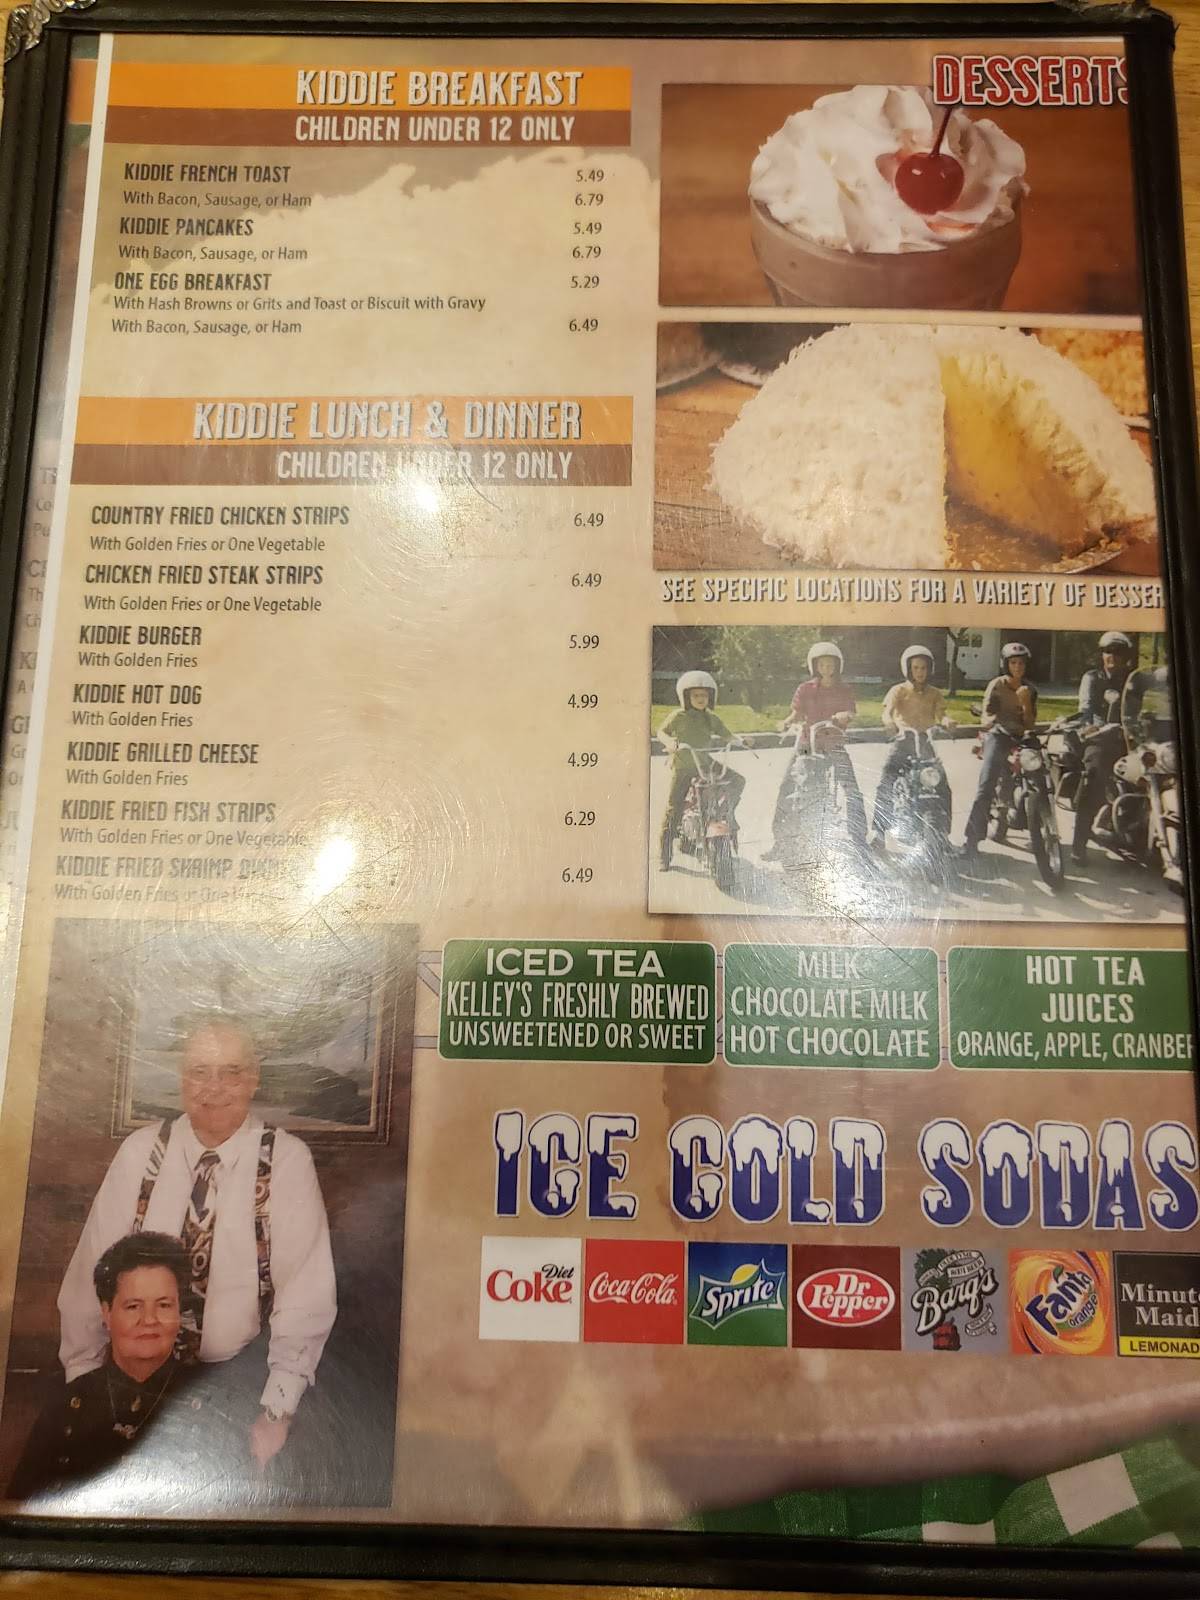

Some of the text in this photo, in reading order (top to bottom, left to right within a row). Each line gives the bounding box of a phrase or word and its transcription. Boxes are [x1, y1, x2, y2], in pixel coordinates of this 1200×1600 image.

[296, 70, 583, 106] KIDDIE BREAKFAST
[296, 116, 575, 141] CHILDREN UNDER 12 ONLY
[124, 163, 291, 183] KIDDIE FRENCH TOAST
[576, 169, 604, 182] 5.49
[124, 190, 312, 210] With Bacon, Sausage, or Ham
[575, 193, 604, 206] 6.79
[120, 216, 254, 236] KIDDIE PANCAKES
[573, 222, 602, 235] 5.49
[119, 245, 308, 263] With Bacon, Sausage, or Ham
[572, 246, 601, 259] 6.79
[114, 272, 272, 291] ONE EGG BREAKFAST
[571, 275, 599, 288] 5.29
[114, 295, 486, 312] With Hash Browns or Grits and Toast or Biscuit with Gravy
[112, 319, 302, 337] With Bacon, Sausage, or Ham
[569, 319, 599, 332] 6.49
[193, 401, 581, 440] KIDDIE LUNCH & DINNER
[277, 451, 386, 479] CHILDREN
[482, 451, 506, 479] 12
[516, 451, 573, 479] ONLY
[91, 506, 350, 525] COUNTRY FRIED CHICKEN STRIPS
[574, 512, 604, 527] 6.49
[90, 535, 326, 554] With Golden Fries or One Vegetable
[85, 564, 323, 584] CHICKEN FRIED STEAK STRIPS
[571, 573, 602, 587] 6.49
[660, 577, 696, 602] SEE
[702, 577, 788, 602] SPECIFIC
[795, 577, 902, 603] LOCATIONS
[910, 578, 946, 603] FOR
[953, 579, 967, 604] A
[972, 580, 1056, 606] VARIETY
[1063, 582, 1086, 607] OF
[84, 594, 322, 615] With Golden Fries or One Vegetable
[79, 625, 202, 645] KIDDIE BURGER
[569, 635, 600, 649] 5.99
[78, 652, 198, 668] With Golden Fries
[73, 683, 202, 705] KIDDIE HOT DOG
[568, 693, 598, 708] 4.99
[72, 711, 193, 727] With Golden Fries
[67, 741, 259, 764] KIDDIE GRILLED CHEESE
[568, 752, 598, 767] 4.99
[66, 768, 188, 786] With Golden Fries
[61, 799, 276, 823] KIDDIE FRIED FISH STRIPS
[564, 811, 595, 826] 6.29
[60, 827, 93, 844] With
[97, 828, 146, 844] Golden
[151, 829, 183, 845] Fries
[187, 832, 202, 845] or
[205, 831, 232, 846] One
[56, 855, 109, 877] KIDDIE
[116, 857, 162, 878] FRIED
[170, 858, 232, 879] SHRIMP
[562, 867, 593, 883] 6.49
[54, 883, 87, 899] With
[92, 884, 141, 901] Golden
[486, 948, 665, 978] ICED TEA
[798, 951, 860, 979] MILK
[1026, 955, 1145, 986] HOT TEA
[447, 981, 709, 1021] KELLEY'S FRESHLY BREWED
[730, 986, 928, 1021] CHOCOLATE MILK
[1041, 993, 1134, 1024] JUICES
[450, 1021, 706, 1050] UNSWEETENED OR SWEET
[730, 1025, 930, 1058] HOT CHOCOLATE
[957, 1030, 1040, 1062] ORANGE,
[1044, 1031, 1108, 1062] APPLE,
[494, 1110, 1199, 1231] ICE COLD SODAS
[541, 1263, 574, 1280] Diet
[486, 1268, 573, 1304] Coke
[588, 1271, 677, 1305] Coca-Cola
[836, 1273, 871, 1296] Dr
[1120, 1283, 1199, 1304] Minut
[702, 1280, 776, 1319] Sprite
[808, 1285, 888, 1318] Pepper
[911, 1267, 998, 1336] Barq's
[1024, 1271, 1093, 1336] Fanta
[1068, 1293, 1099, 1328] orange
[1135, 1306, 1199, 1327] Maid
